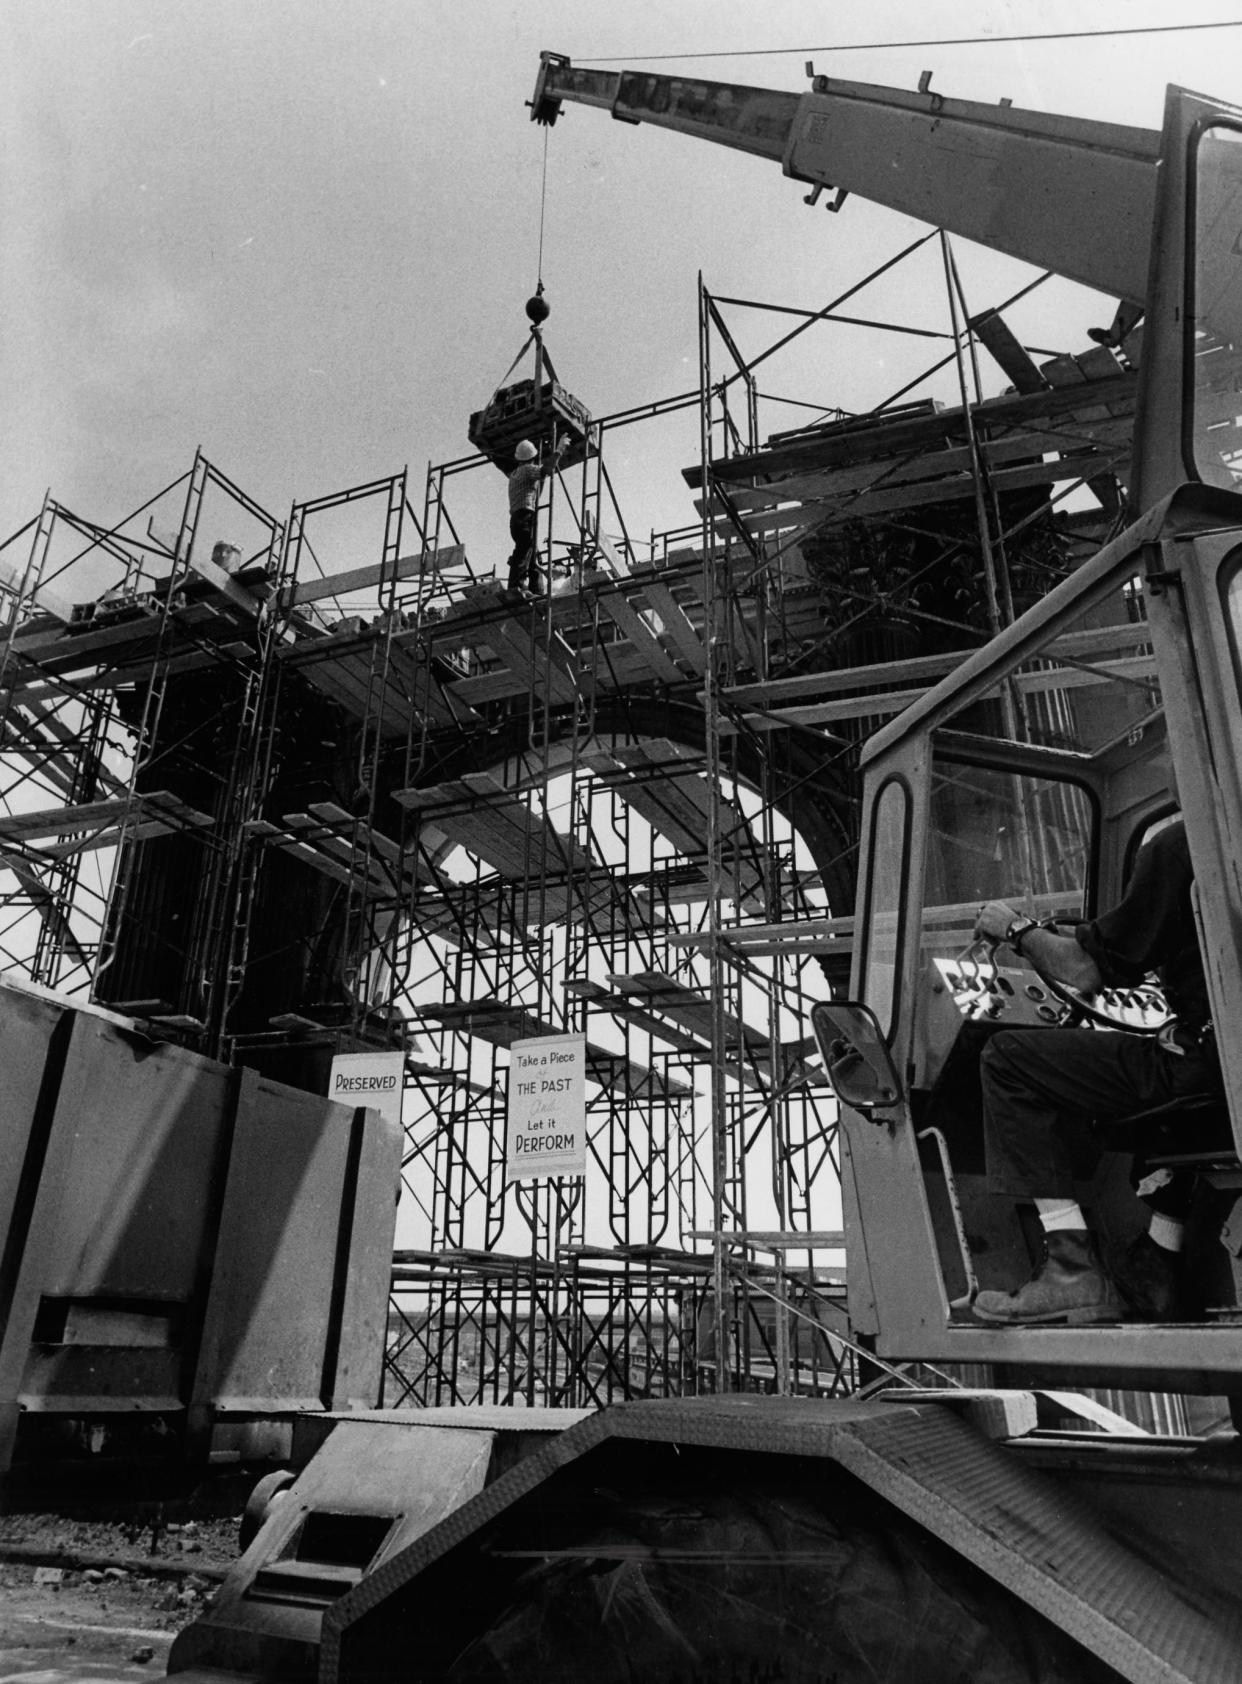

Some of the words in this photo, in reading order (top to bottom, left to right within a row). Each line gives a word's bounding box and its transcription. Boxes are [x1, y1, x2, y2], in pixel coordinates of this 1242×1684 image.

[517, 1055, 539, 1068] Take
[540, 1056, 547, 1065] a
[549, 1051, 575, 1064] Piece
[335, 1073, 397, 1091] PRESERVED
[516, 1081, 537, 1096] THE
[541, 1078, 572, 1093] PAST
[527, 1119, 544, 1131] Let
[547, 1117, 556, 1129] it
[515, 1133, 575, 1154] PERFORM
